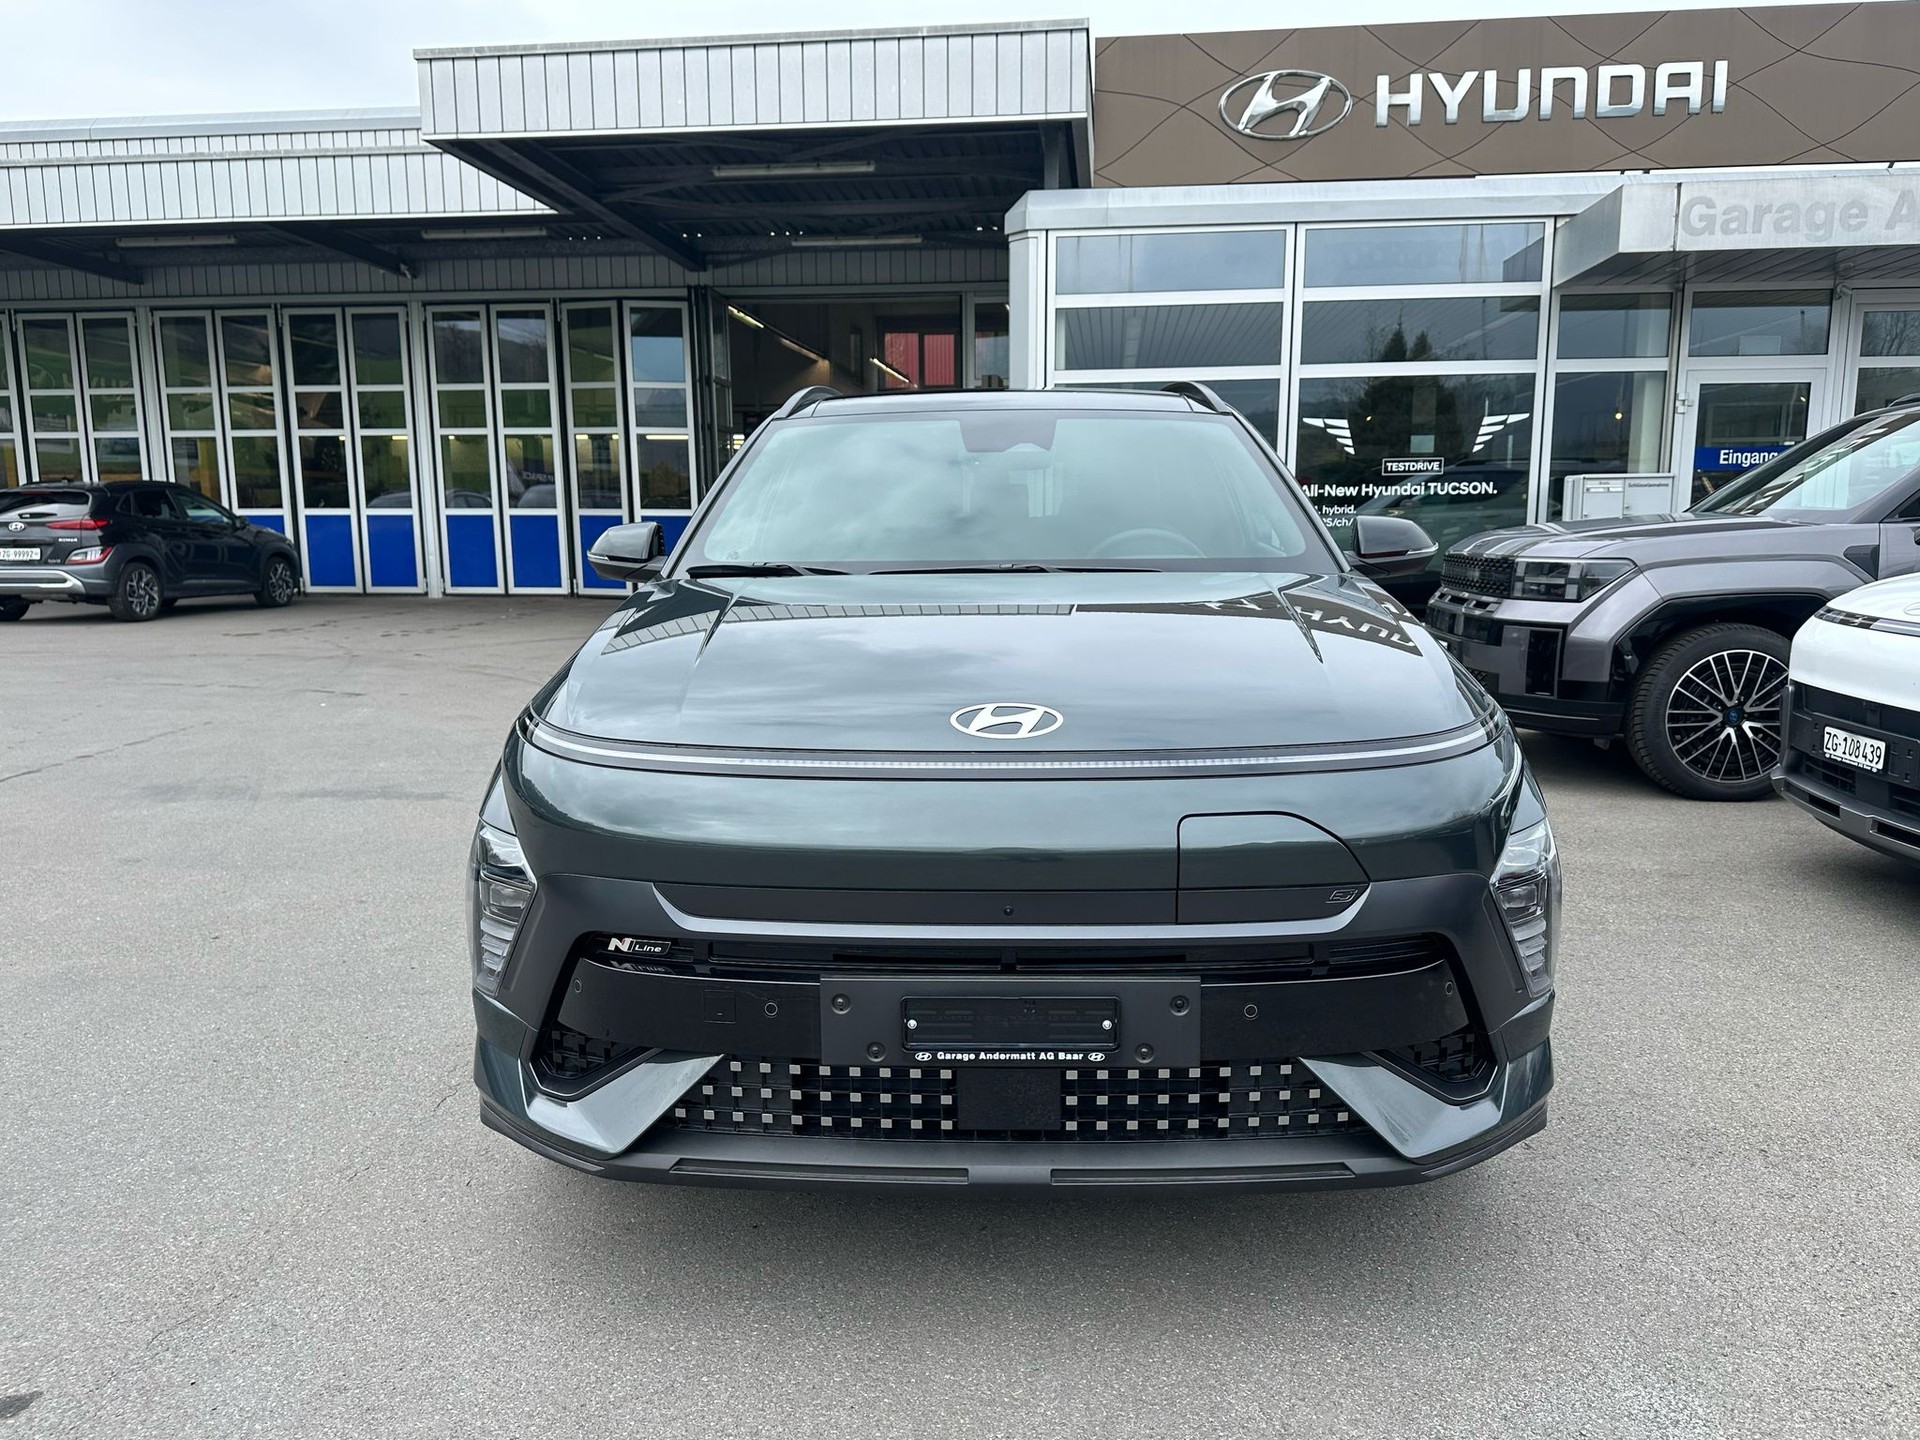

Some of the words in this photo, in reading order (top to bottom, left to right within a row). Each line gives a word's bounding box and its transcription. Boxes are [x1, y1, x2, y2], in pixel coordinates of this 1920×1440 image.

[1375, 60, 1729, 127] HYUNDAI
[1681, 196, 1869, 243] Garage
[1386, 461, 1440, 472] TESTDRIVE
[1301, 484, 1358, 497] All-New
[1361, 482, 1425, 499] Hyundai
[1427, 481, 1498, 495] TUCSON.
[1322, 504, 1357, 516] hybrid.
[607, 937, 635, 952] N
[635, 944, 662, 952] Line
[936, 1052, 976, 1062] Garage
[979, 1051, 1036, 1060] Andermatt
[1039, 1051, 1055, 1060] AG
[1058, 1051, 1084, 1060] Baar
